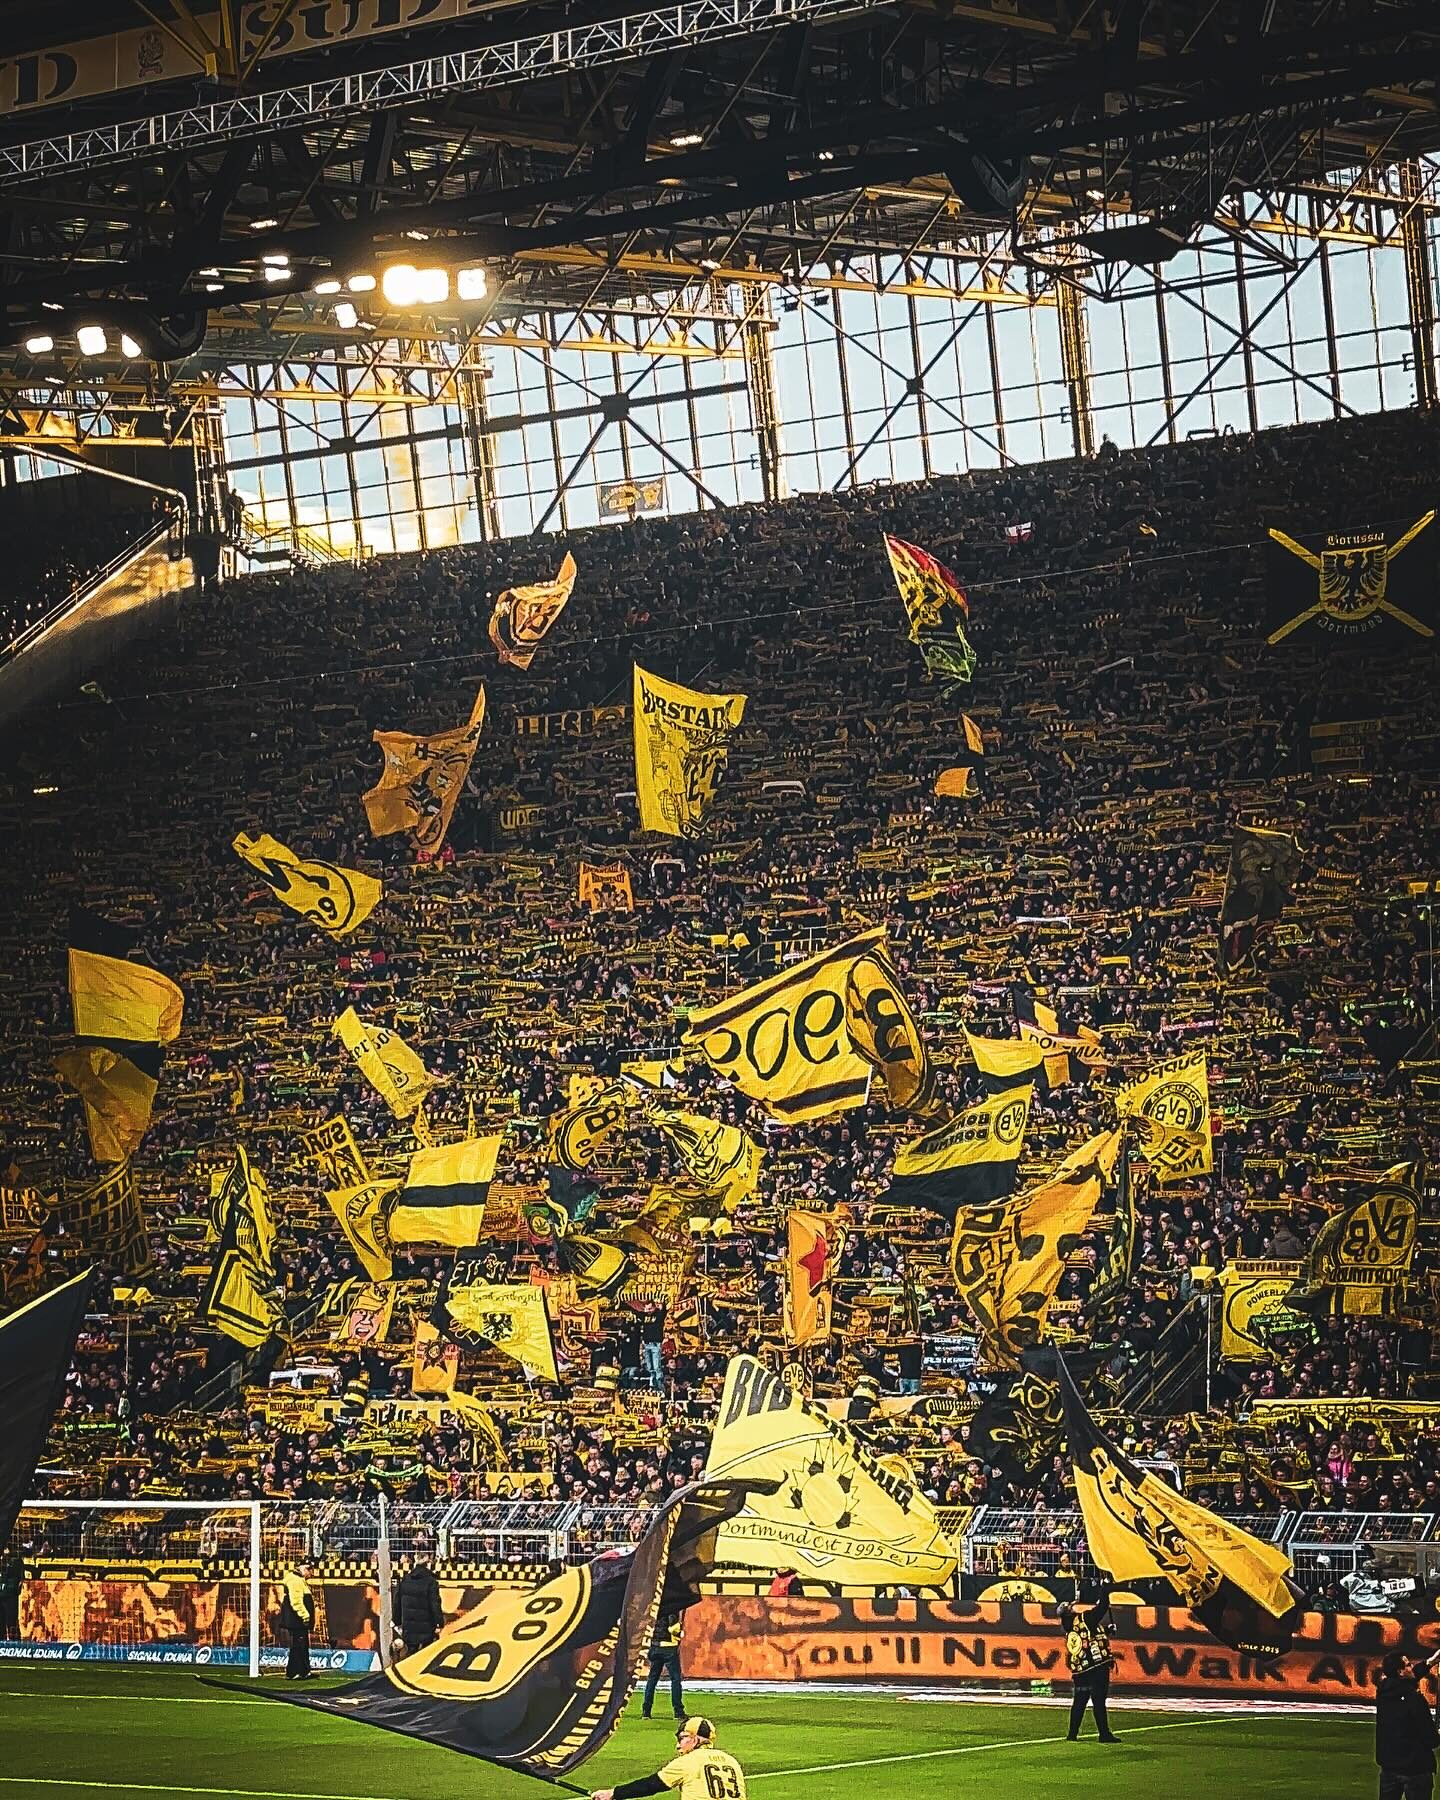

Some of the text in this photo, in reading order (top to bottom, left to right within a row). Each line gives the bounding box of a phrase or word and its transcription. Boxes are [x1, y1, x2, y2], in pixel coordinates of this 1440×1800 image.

[1327, 532, 1385, 546] Borussia
[1317, 615, 1384, 634] Dortmund
[784, 1365, 803, 1382] BVB
[719, 1520, 808, 1545] Dortmund
[812, 1534, 841, 1551] Ost
[846, 1541, 885, 1557] 1995
[511, 1596, 563, 1641] 09
[0, 1647, 63, 1659] SIGNAL IDUNA
[127, 1650, 193, 1663] SIGNAL IDUNA
[259, 1655, 290, 1667] SIGNA
[769, 1636, 921, 1667] You'll
[1133, 1645, 1286, 1684] Walk
[576, 1656, 603, 1690] BVB
[704, 1763, 741, 1800] 63
